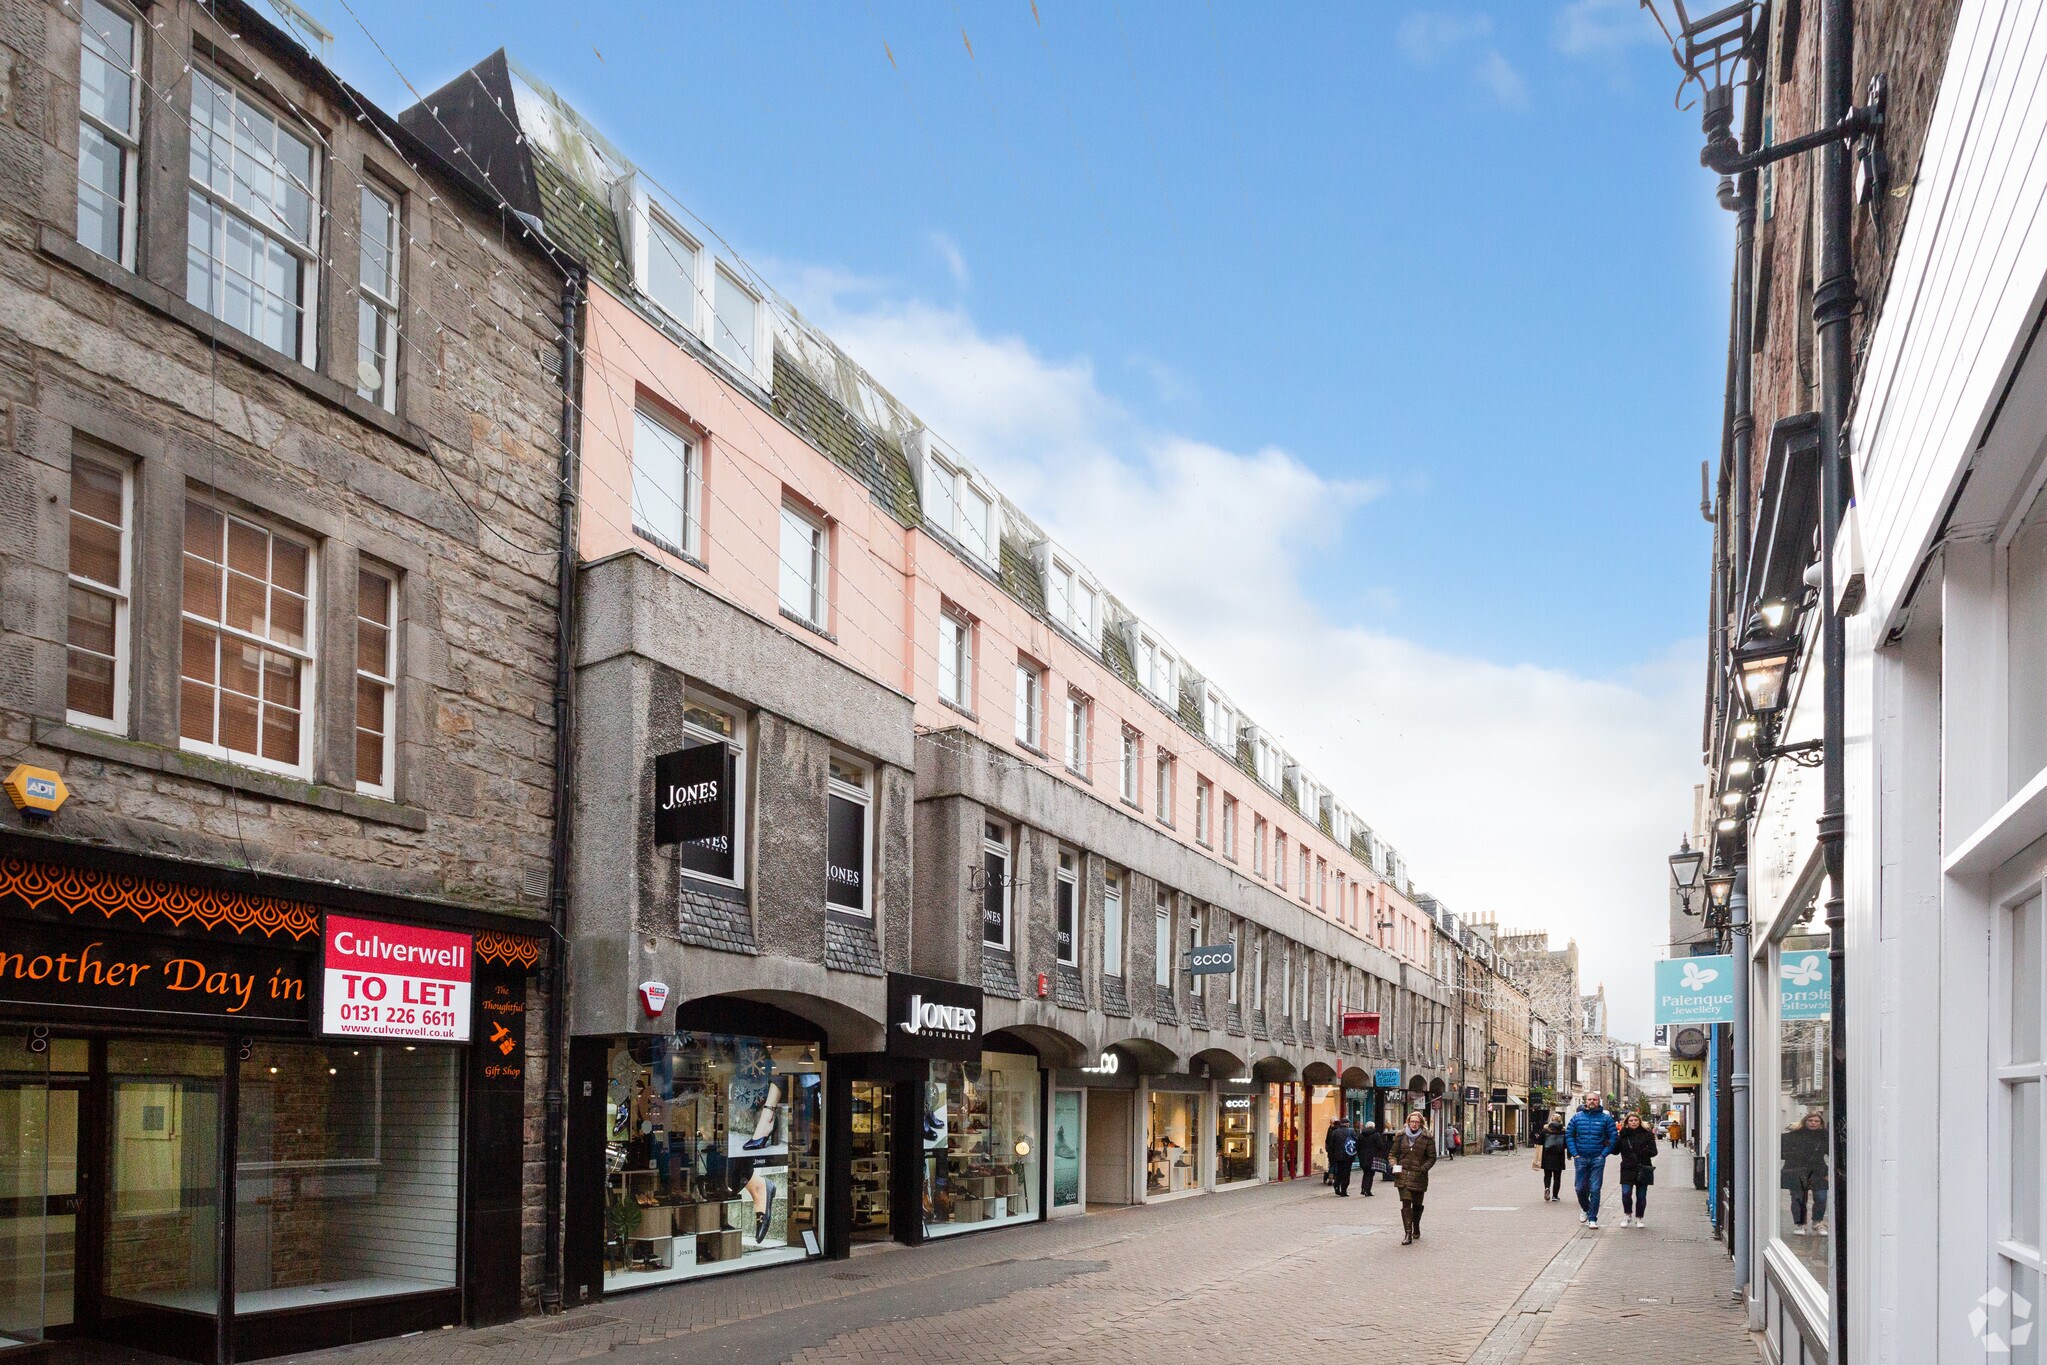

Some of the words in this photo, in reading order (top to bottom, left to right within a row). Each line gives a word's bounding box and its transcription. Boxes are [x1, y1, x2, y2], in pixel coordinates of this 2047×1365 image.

[28, 782, 55, 796] ADT
[662, 781, 718, 810] JONES
[334, 931, 466, 968] Culverwell
[1193, 953, 1232, 966] ecco
[0, 942, 151, 987] nother
[164, 958, 255, 1013] Day
[268, 968, 306, 1001] in
[341, 974, 388, 1002] TO
[402, 980, 456, 1007] LET
[495, 985, 510, 995] The
[482, 1000, 525, 1016] Thoughtful
[1662, 994, 1734, 1008] Palenque
[340, 1003, 379, 1022] 0131
[386, 1008, 416, 1025] 226
[422, 1010, 456, 1027] 6611
[900, 994, 977, 1034] JONES
[1672, 1006, 1722, 1015] Jewellery
[341, 1025, 455, 1038] www.culverwell.co.uk
[485, 1065, 501, 1078] Gift
[502, 1065, 521, 1079] Shop
[1672, 1064, 1690, 1077] FLY
[1226, 1100, 1250, 1108] ecco
